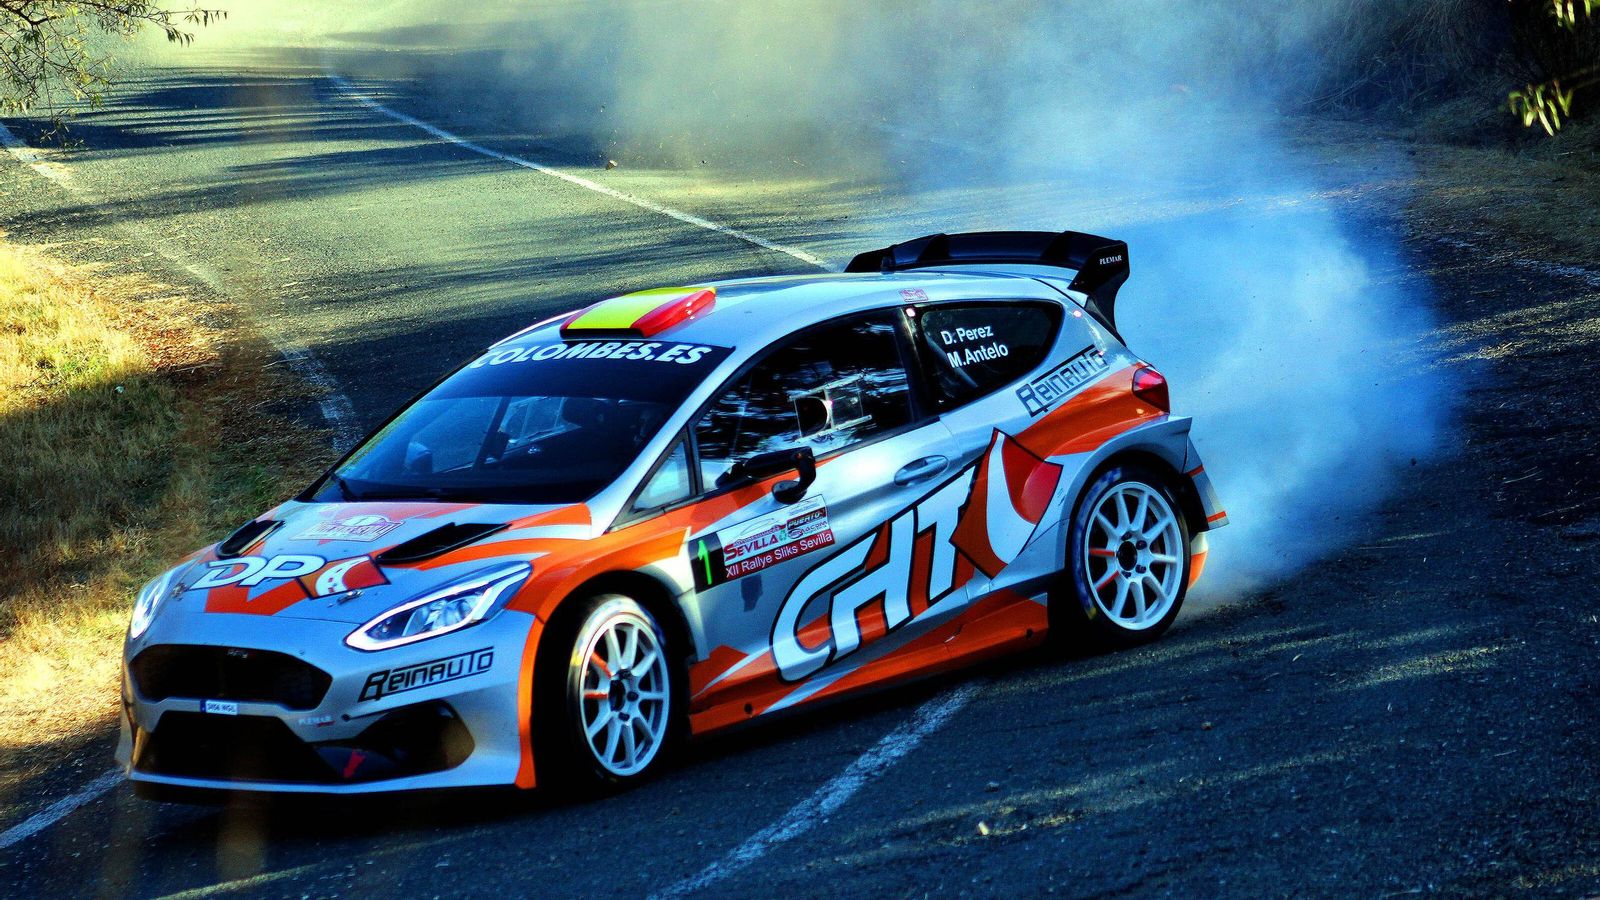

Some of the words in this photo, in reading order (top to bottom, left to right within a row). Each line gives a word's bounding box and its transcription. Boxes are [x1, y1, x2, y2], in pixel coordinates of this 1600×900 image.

[1099, 254, 1122, 265] PLEMAR
[940, 330, 957, 345] D.
[955, 325, 994, 342] Perez
[469, 342, 712, 369] COLOMBES.ES
[947, 341, 1009, 368] M.Antelo
[723, 533, 779, 561] SEVILLA
[725, 564, 739, 578] XII
[741, 555, 773, 573] Rallye
[774, 546, 798, 560] Sliks
[800, 531, 833, 551] Sevilla
[697, 539, 712, 585] 1
